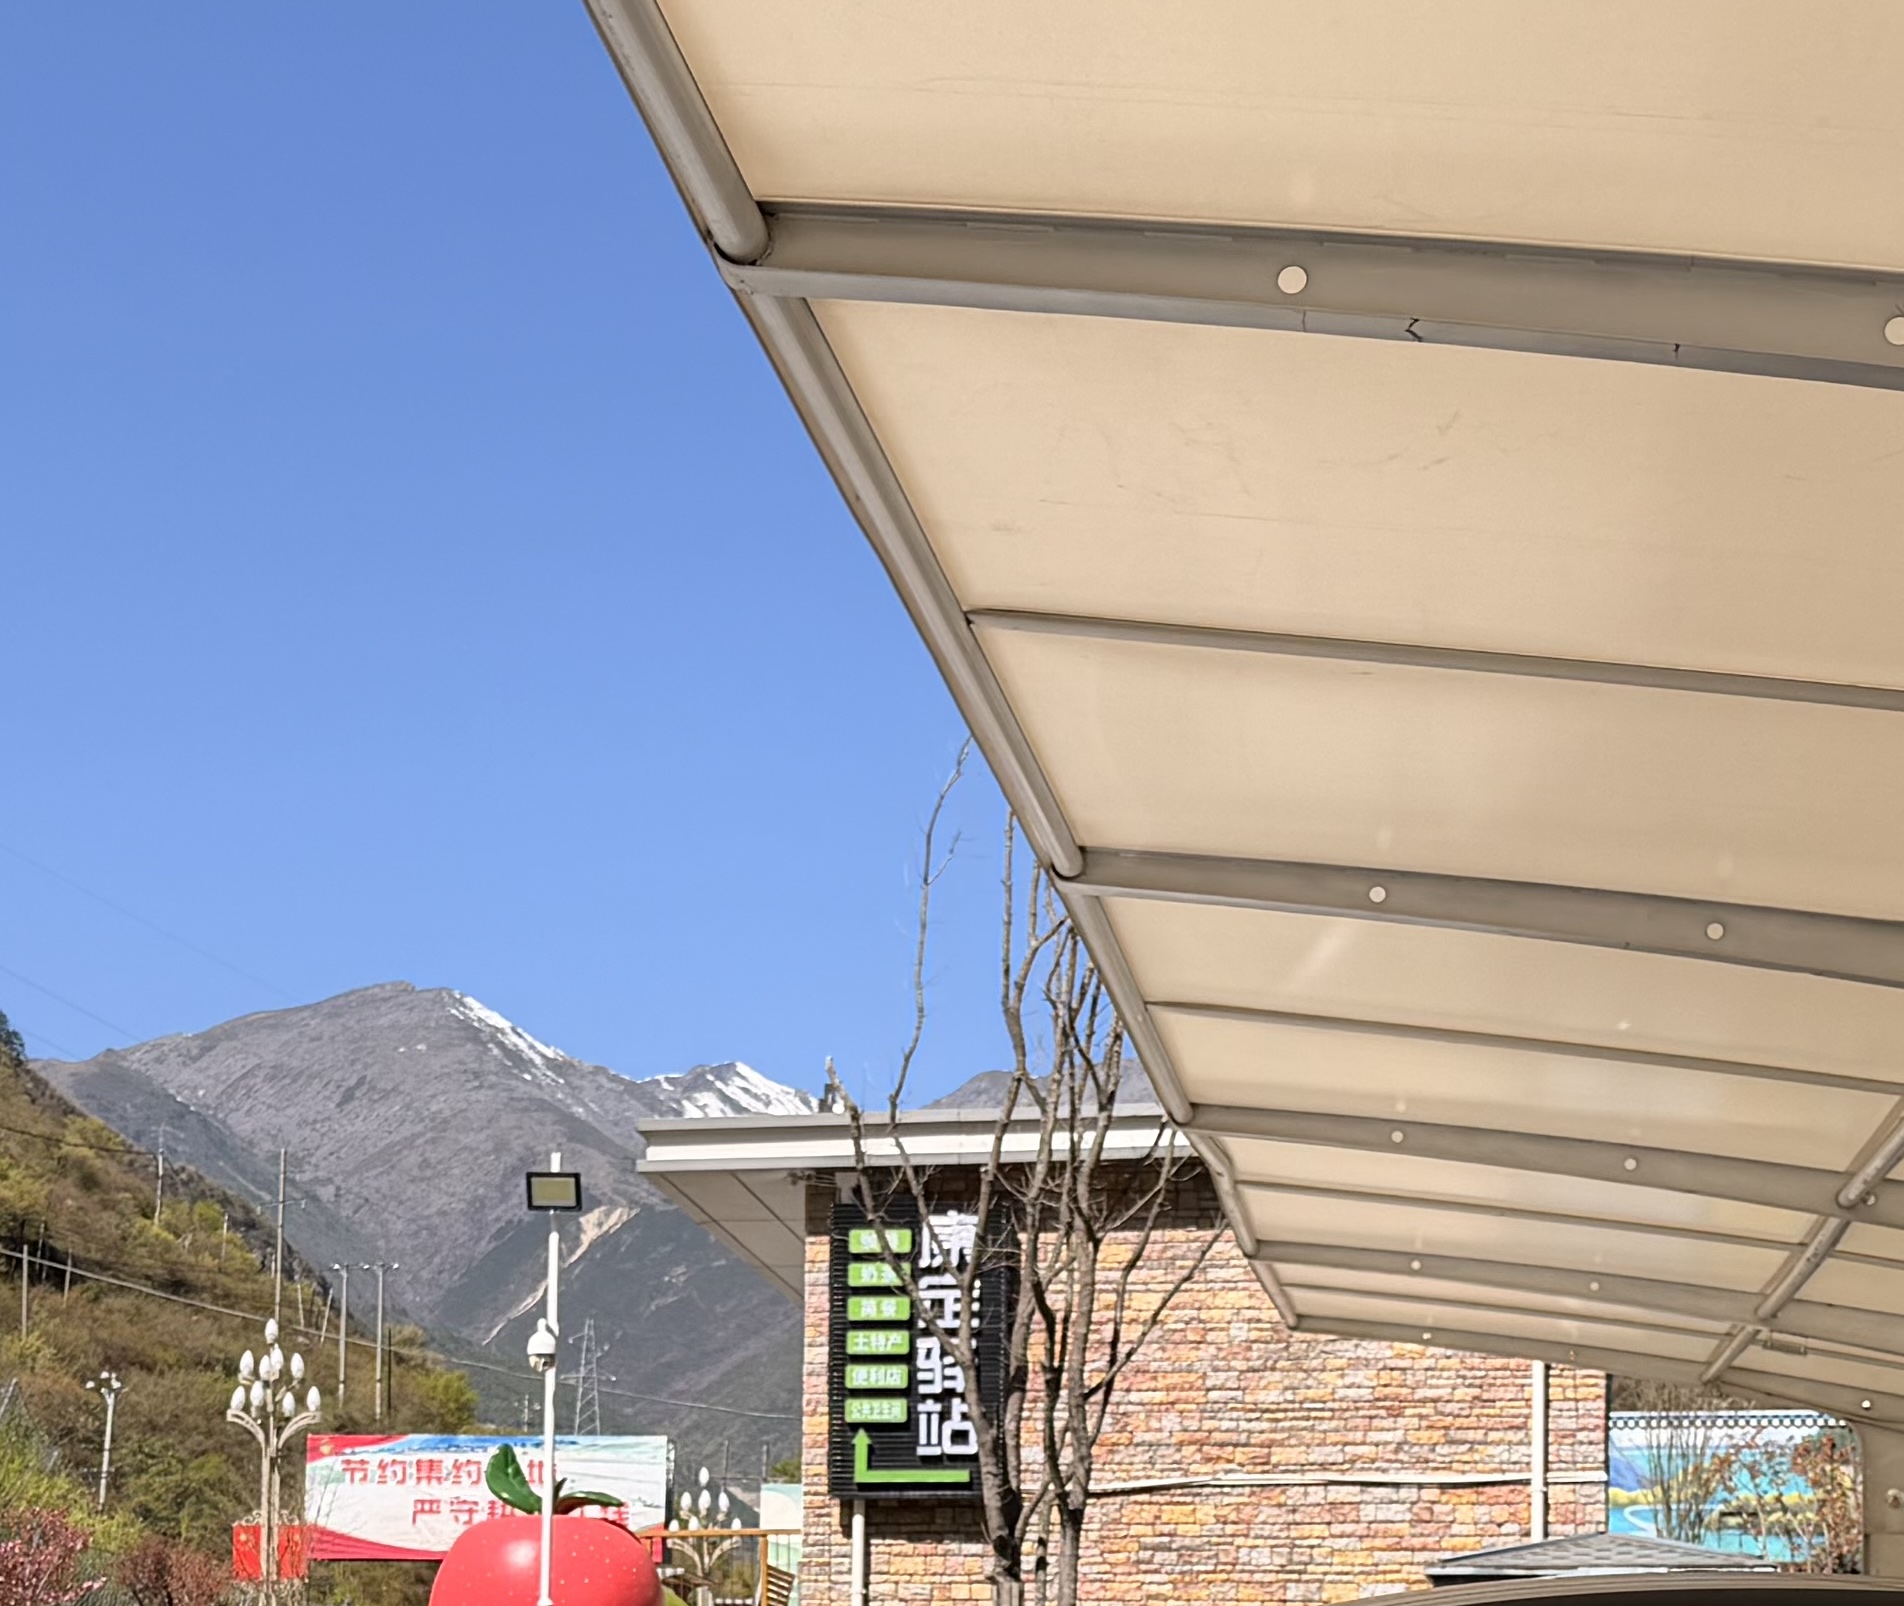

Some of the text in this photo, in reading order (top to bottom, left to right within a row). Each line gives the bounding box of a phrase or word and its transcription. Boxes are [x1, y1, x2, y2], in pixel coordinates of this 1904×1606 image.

[853, 1332, 903, 1352] 土特产
[917, 1210, 980, 1455] 康定驿站
[852, 1367, 902, 1386] 便利店
[341, 1459, 558, 1486] 节约集约地
